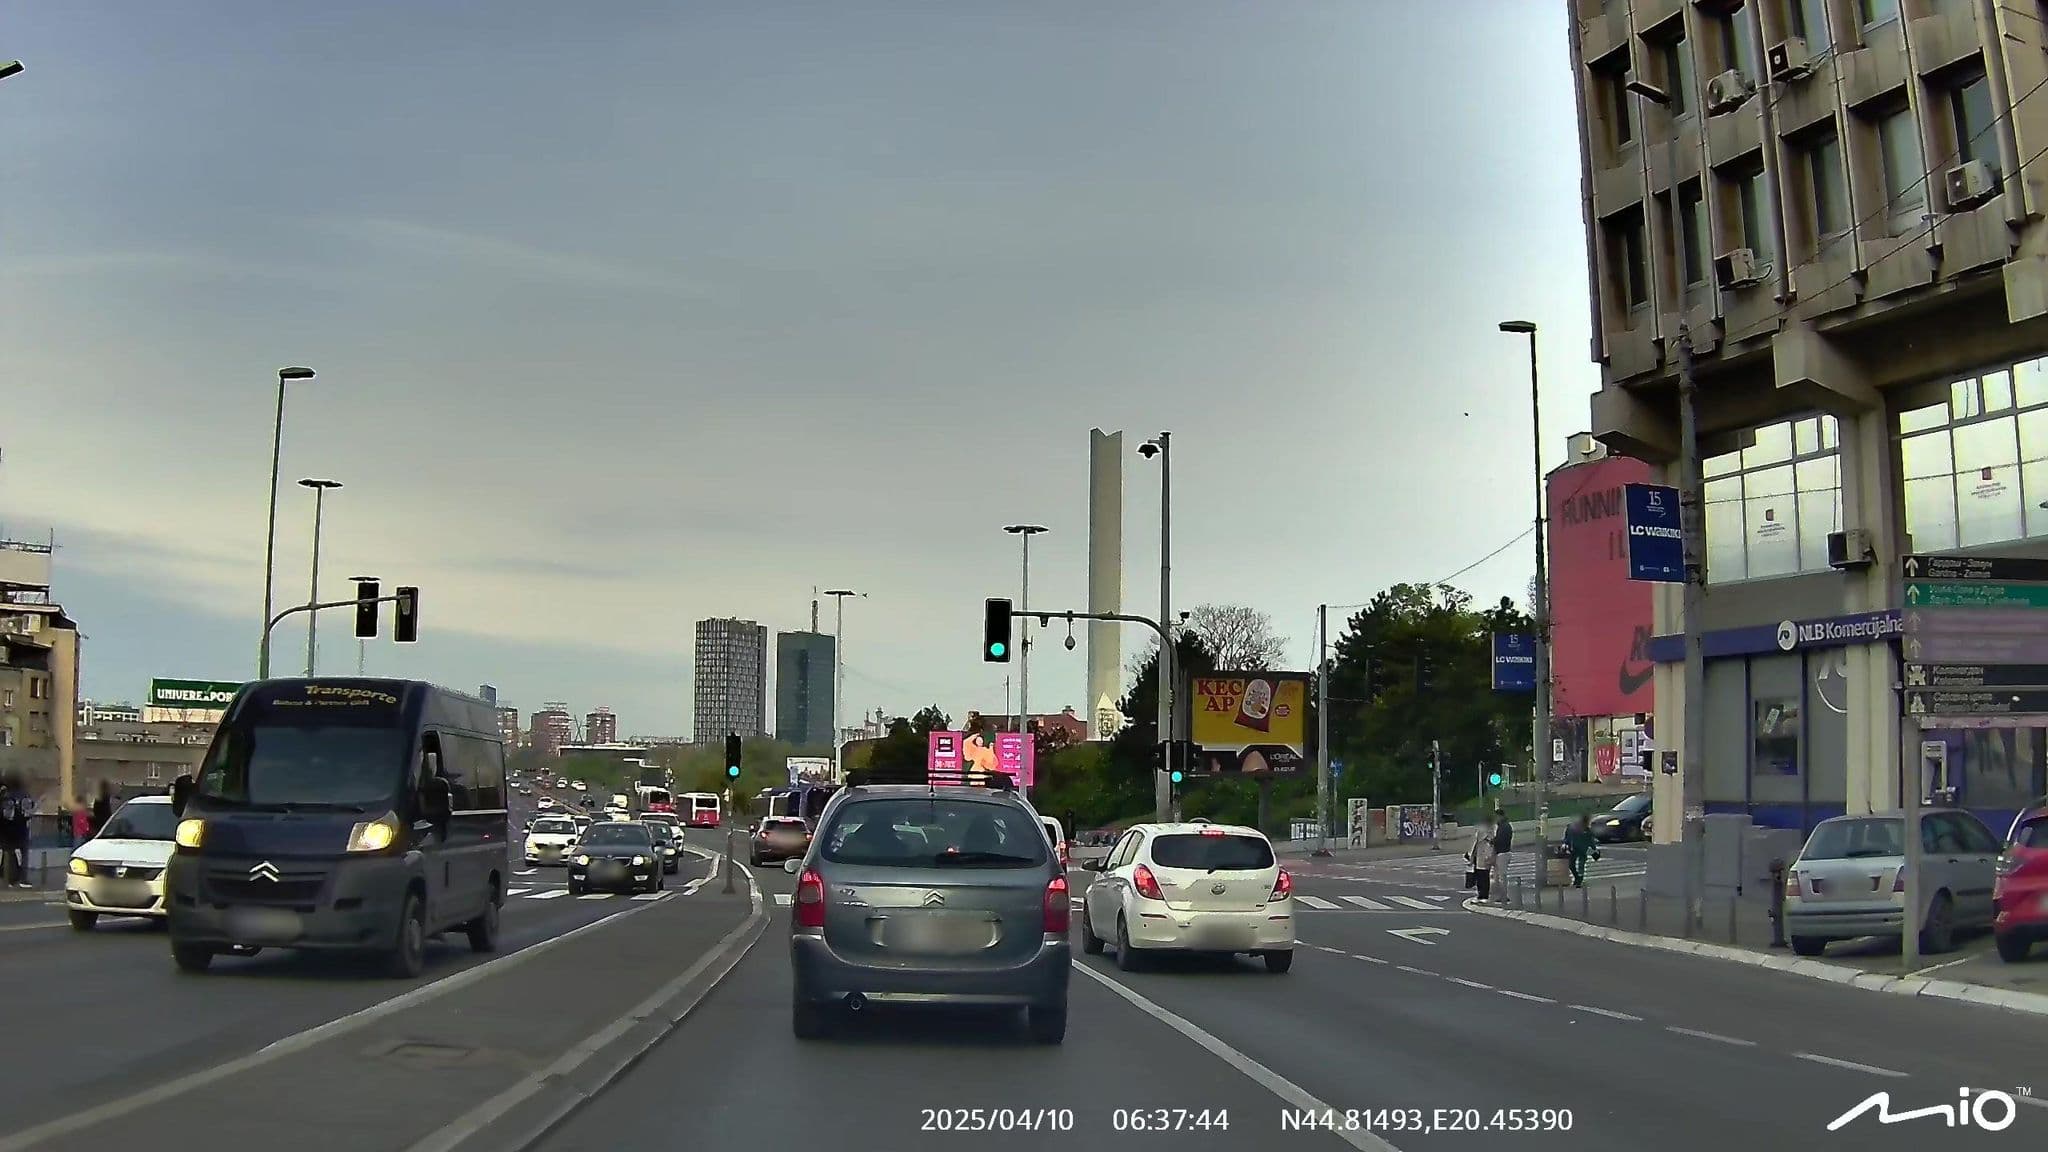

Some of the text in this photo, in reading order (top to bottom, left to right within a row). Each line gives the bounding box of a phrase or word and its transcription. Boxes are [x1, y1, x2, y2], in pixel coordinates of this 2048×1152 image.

[1648, 491, 1661, 505] 15
[1630, 525, 1644, 536] LC
[1800, 623, 1825, 641] NLB
[1198, 680, 1241, 695] KEC
[1205, 696, 1235, 711] AP
